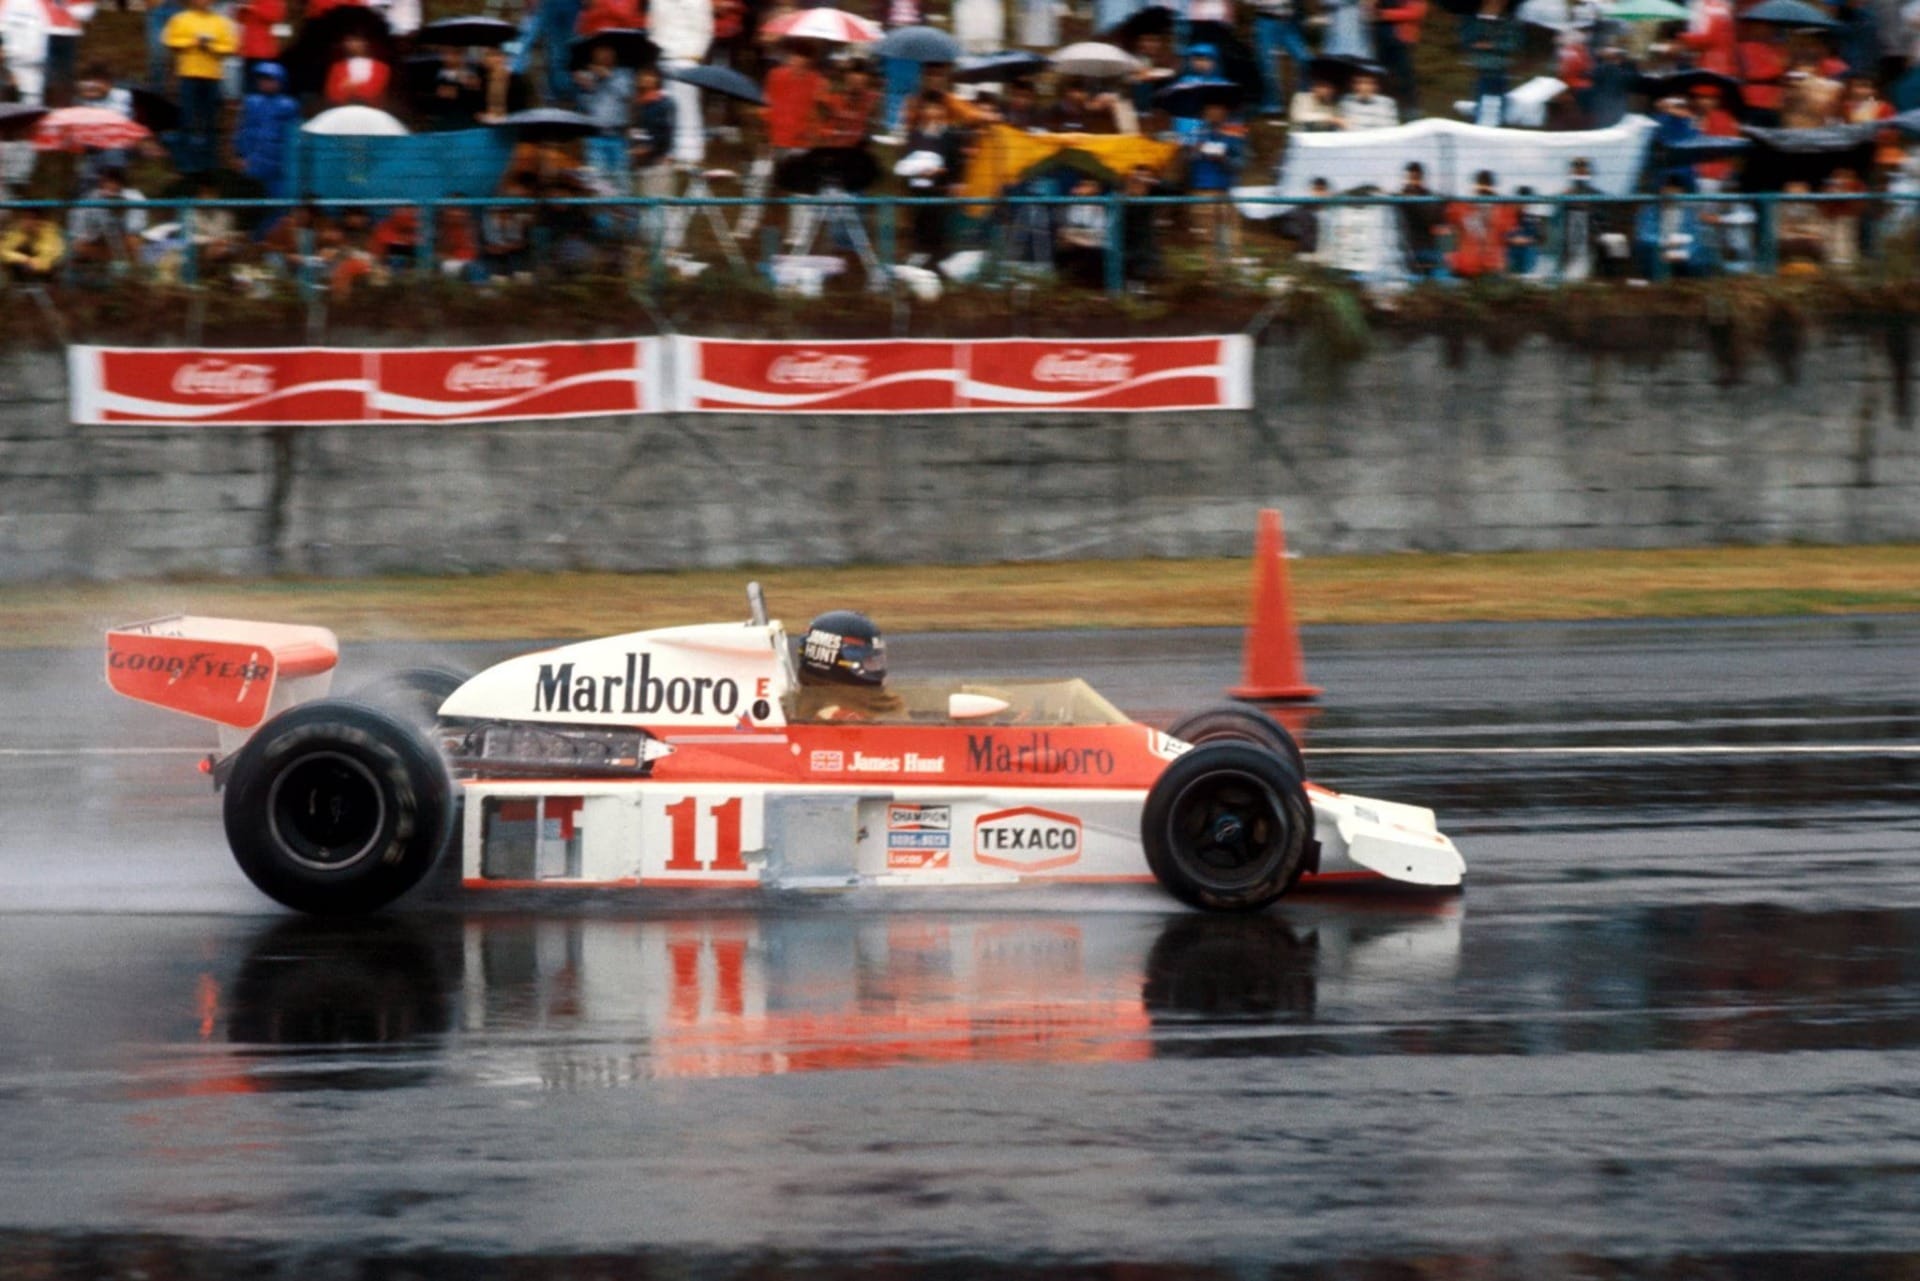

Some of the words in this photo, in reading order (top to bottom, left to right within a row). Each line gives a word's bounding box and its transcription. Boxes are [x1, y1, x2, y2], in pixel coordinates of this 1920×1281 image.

[805, 643, 838, 664] HUNT
[533, 653, 739, 715] Marlboro
[756, 678, 770, 697] E
[848, 751, 900, 772] James
[904, 753, 945, 773] Hunt
[967, 732, 1115, 774] Marlboro
[892, 810, 948, 823] CHAMPION
[665, 796, 747, 870] 11
[980, 828, 1077, 850] TEXACO
